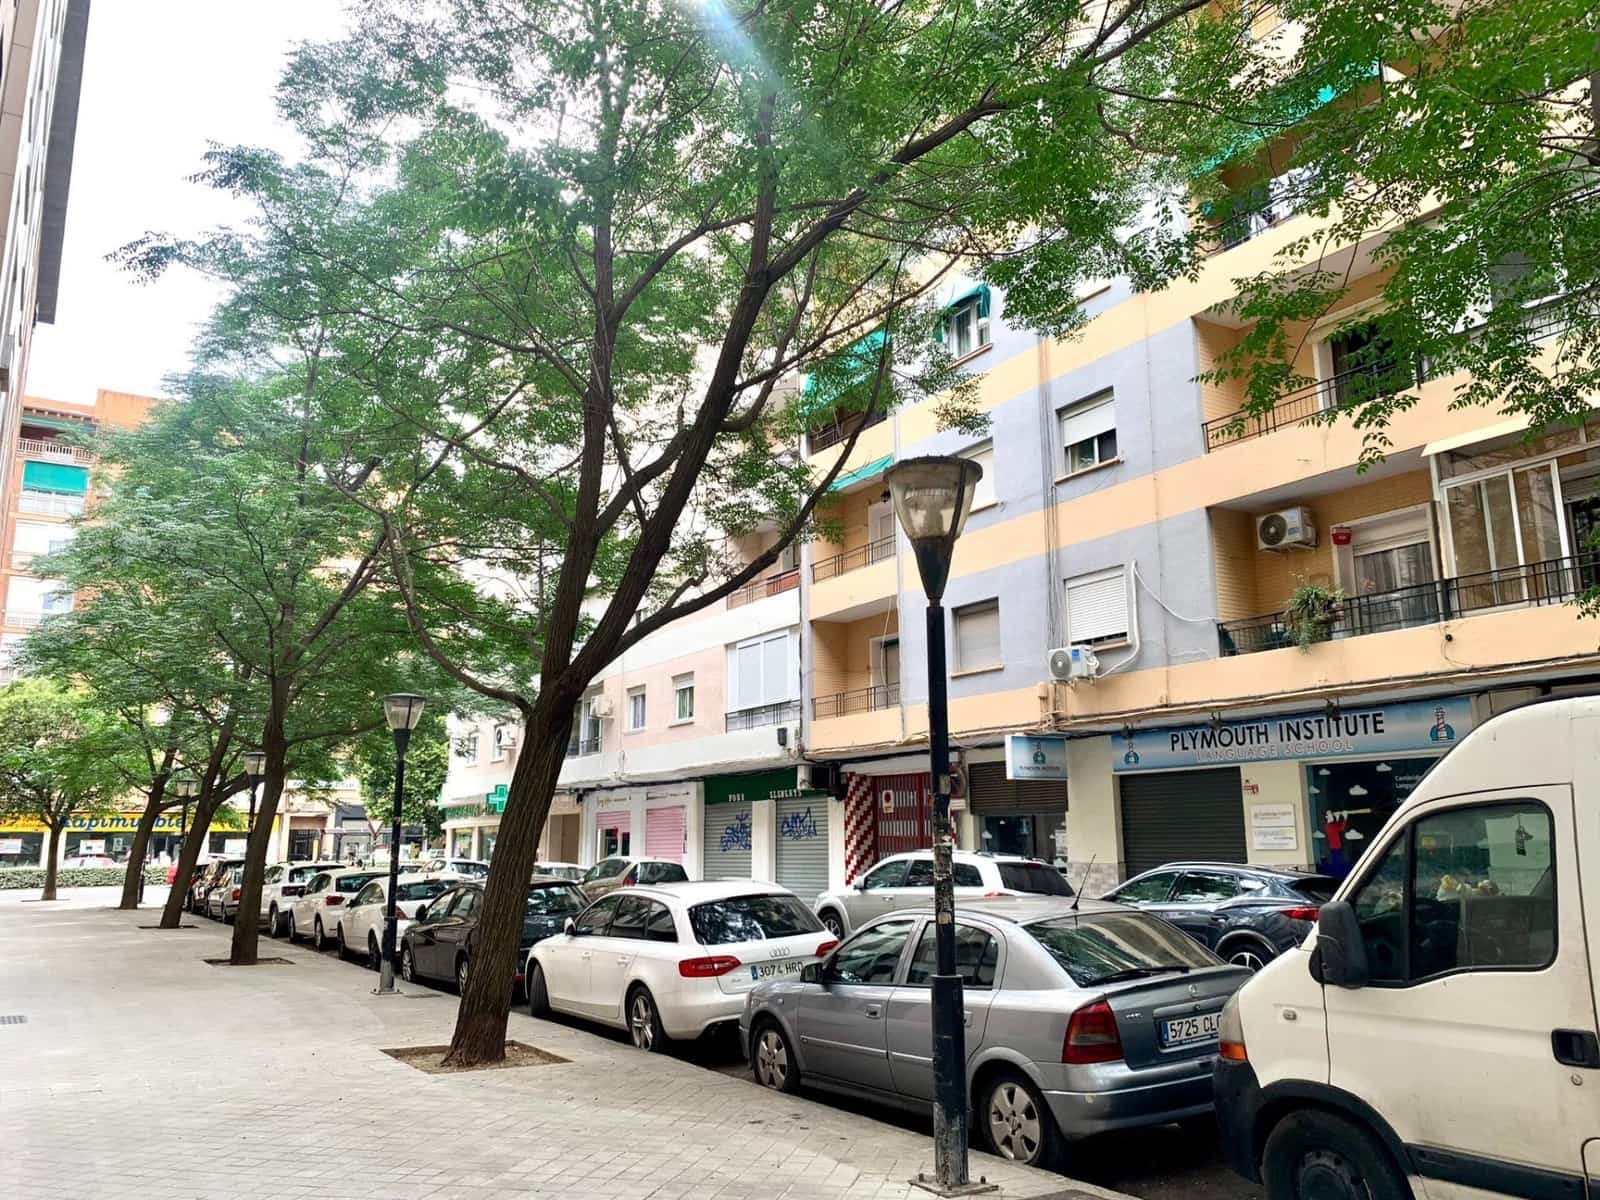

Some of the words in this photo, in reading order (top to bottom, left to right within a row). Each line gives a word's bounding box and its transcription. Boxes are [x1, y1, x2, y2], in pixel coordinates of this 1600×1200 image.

[1171, 723, 1269, 751] PLYMOUTH
[1279, 712, 1385, 743] INSTITUTE
[1197, 743, 1279, 762] LANGUAGE
[1285, 739, 1354, 759] SCHOOL
[1170, 1018, 1199, 1039] 5725
